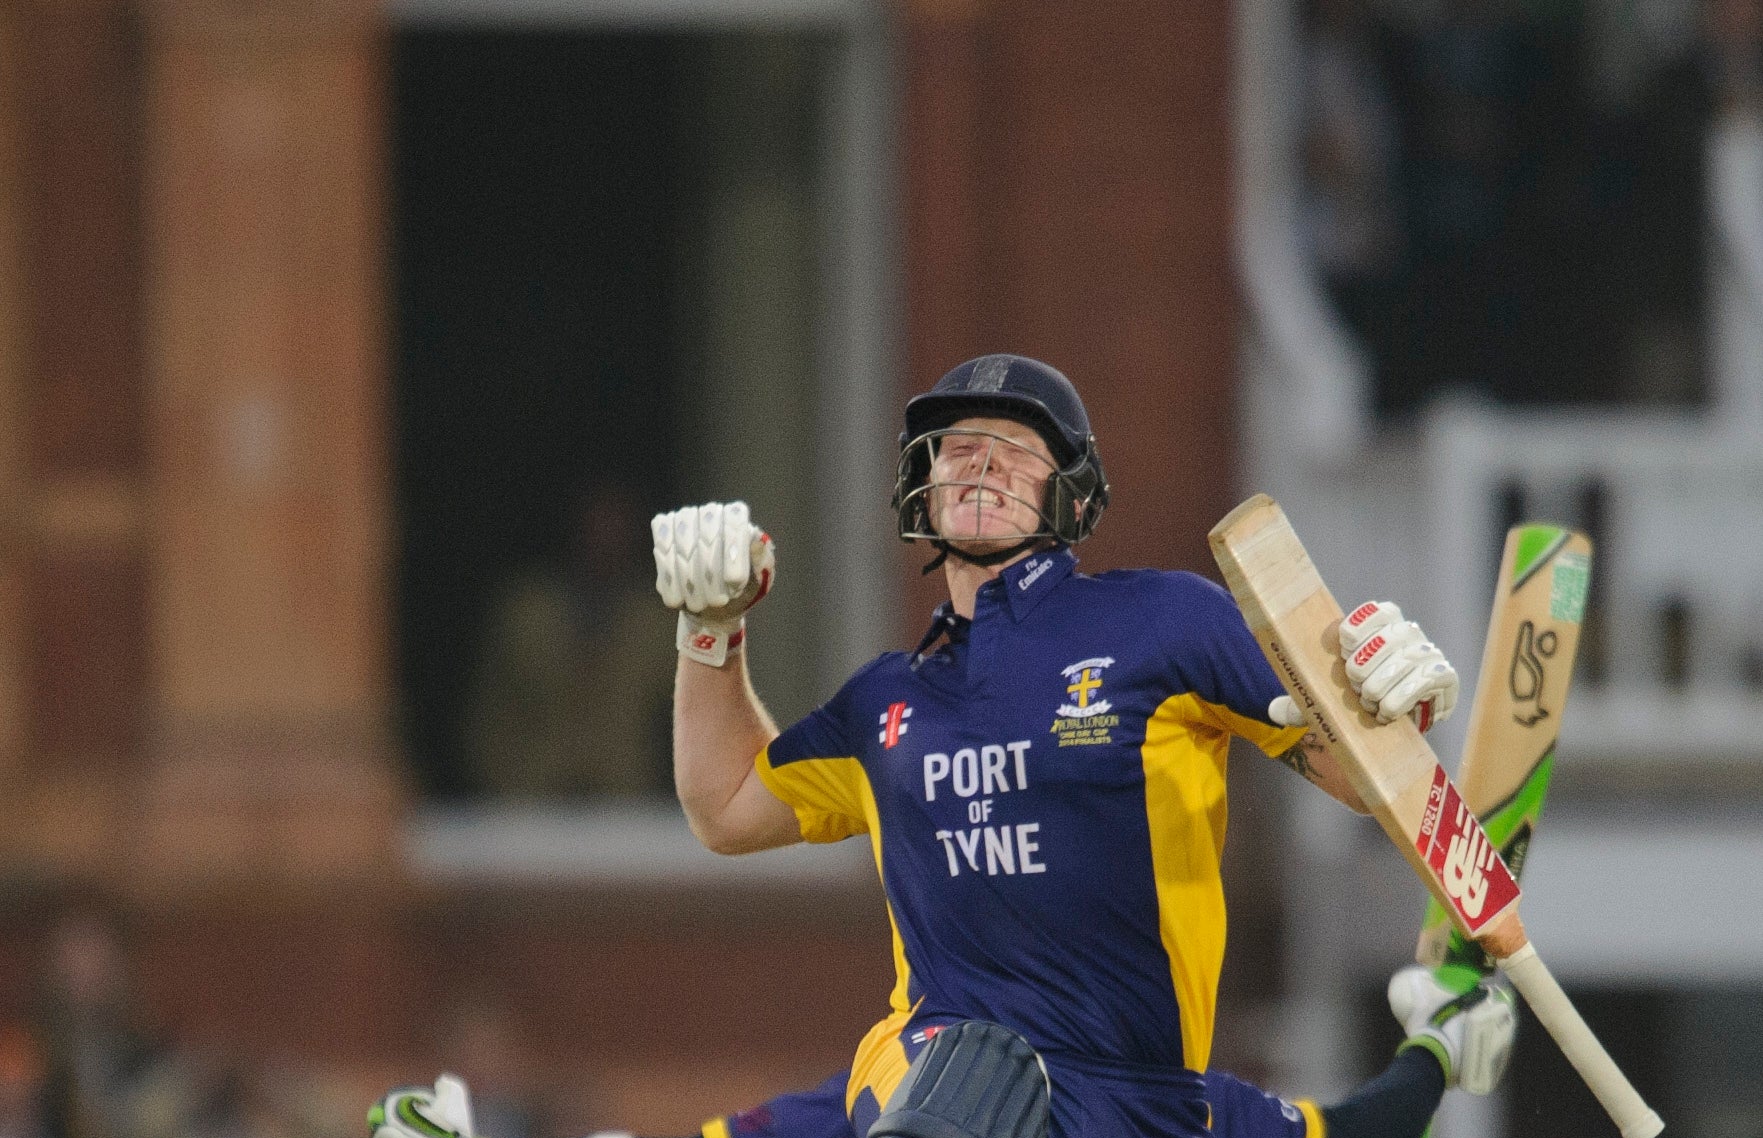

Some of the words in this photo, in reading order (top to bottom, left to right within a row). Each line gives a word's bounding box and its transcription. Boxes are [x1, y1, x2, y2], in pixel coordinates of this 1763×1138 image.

[1018, 558, 1053, 590] Emirates
[1271, 642, 1314, 708] balance
[1313, 712, 1337, 743] new
[924, 740, 1031, 801] PORT
[1430, 783, 1442, 802] TC
[968, 799, 993, 824] OF
[1421, 804, 1439, 835] 1260
[936, 823, 1046, 877] TYNE
